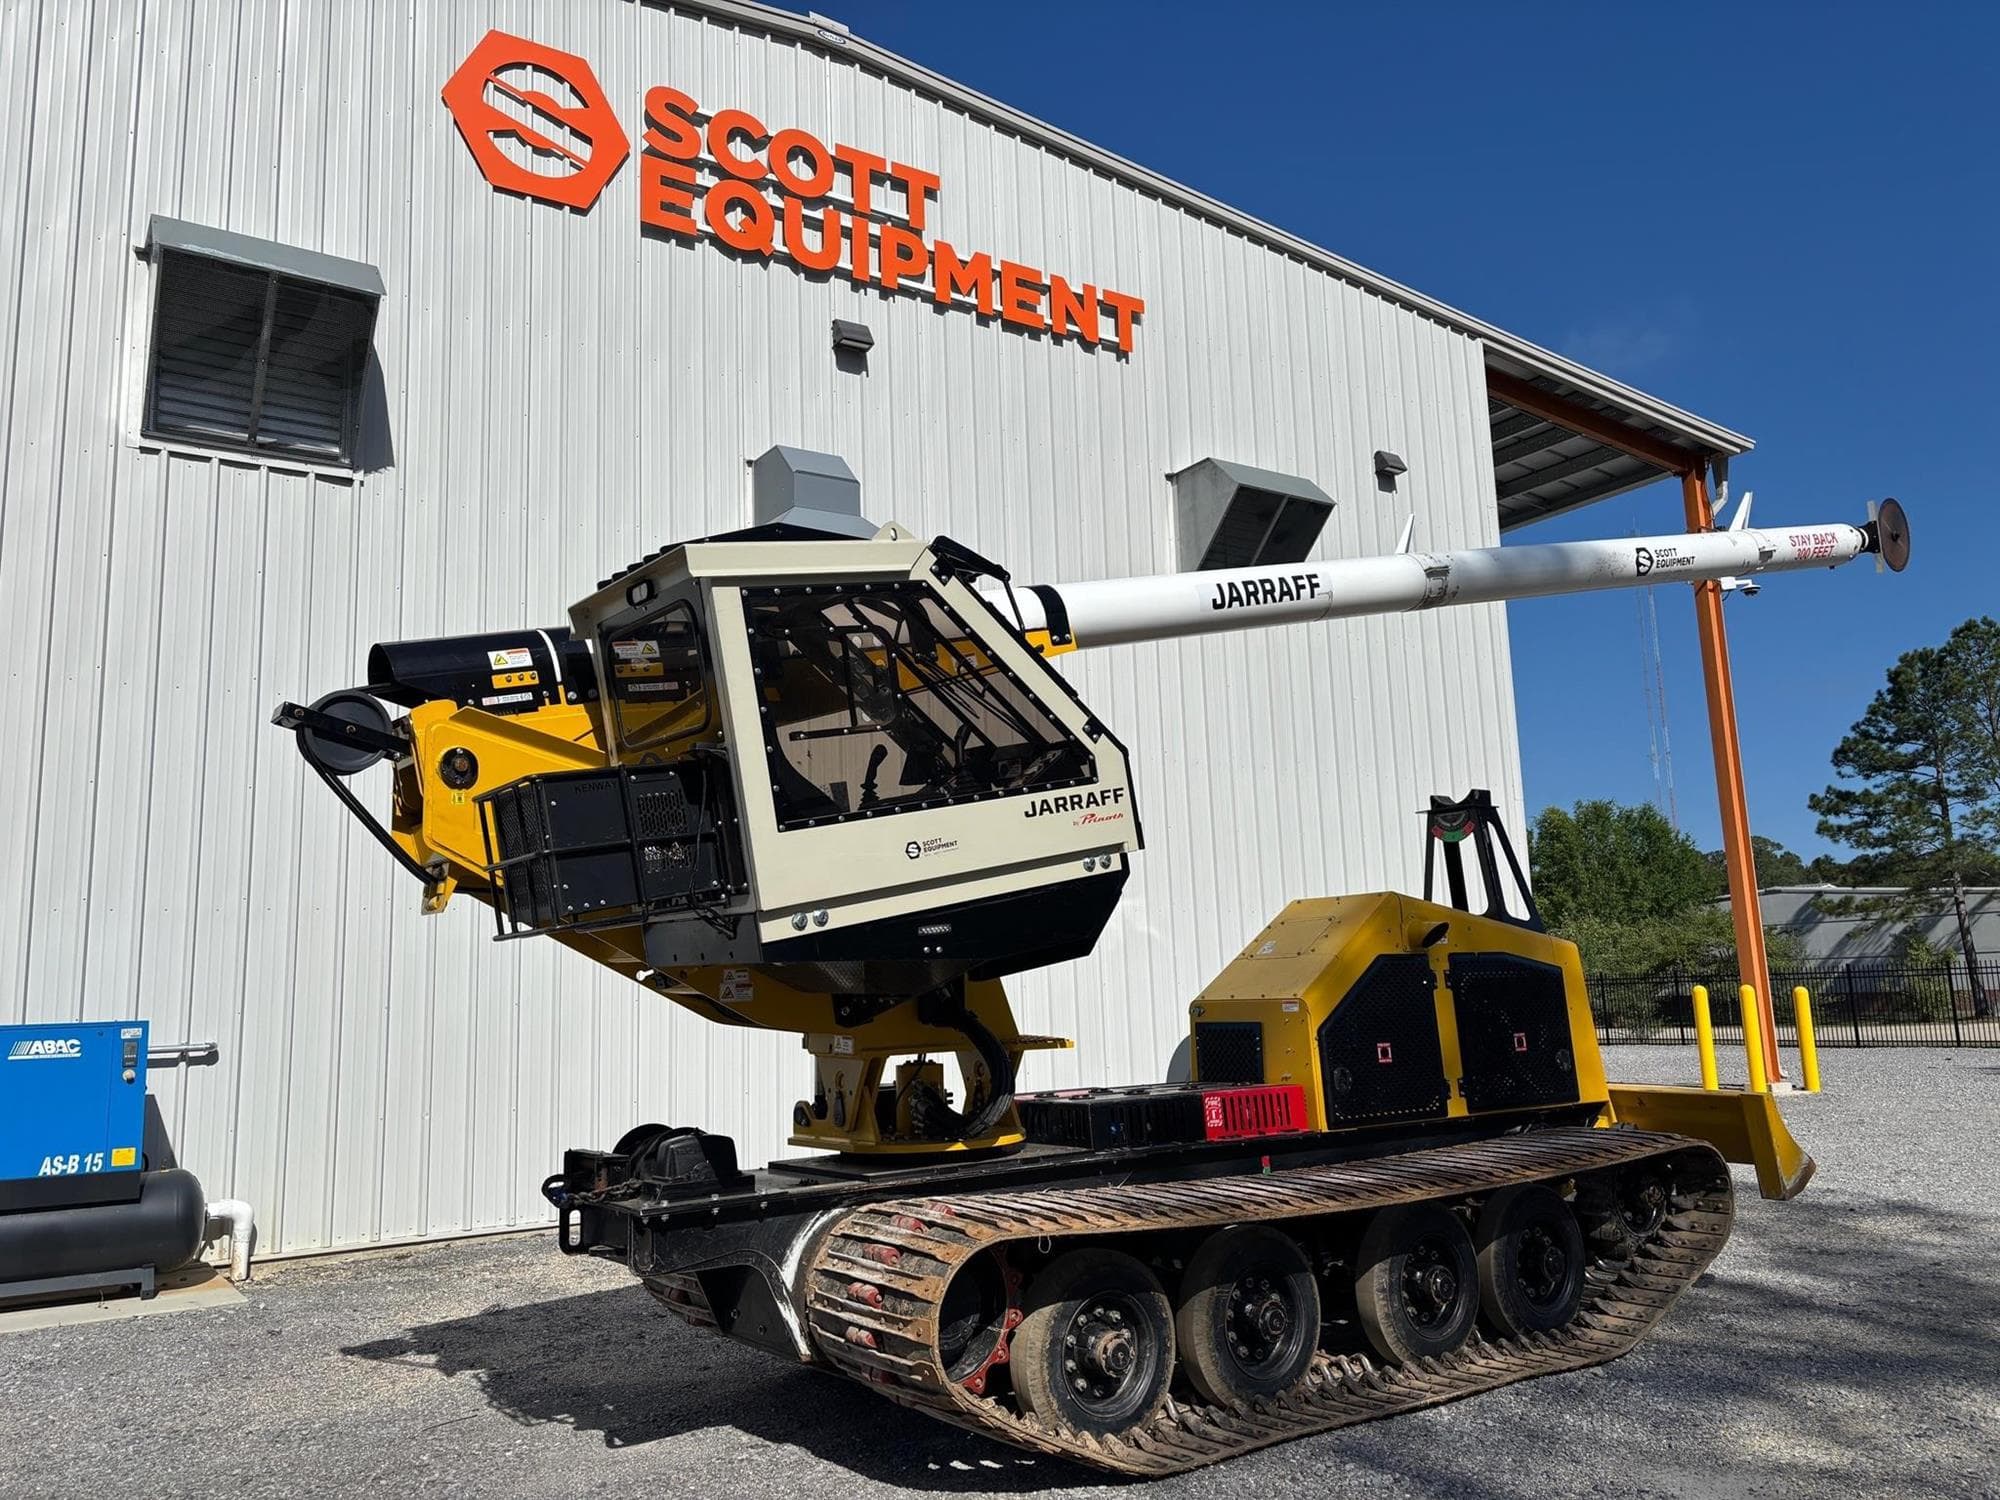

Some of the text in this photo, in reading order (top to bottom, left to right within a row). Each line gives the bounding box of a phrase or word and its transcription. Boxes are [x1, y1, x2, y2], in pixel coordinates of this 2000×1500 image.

[642, 86, 940, 231] SCOTT
[641, 155, 1145, 353] EQUIPMENT
[1789, 532, 1839, 547] STAY BACK
[1654, 547, 1678, 558] SCOTT
[1810, 545, 1835, 559] FEET
[1655, 556, 1696, 569] EQUIPMENT
[1211, 573, 1321, 610] JARRAFF
[1024, 787, 1125, 818] JARRAFF
[922, 837, 942, 847] SCOTT
[923, 840, 958, 853] EQUIPMENT
[28, 1039, 81, 1055] ABAC
[38, 1151, 104, 1176] AS-B 15
